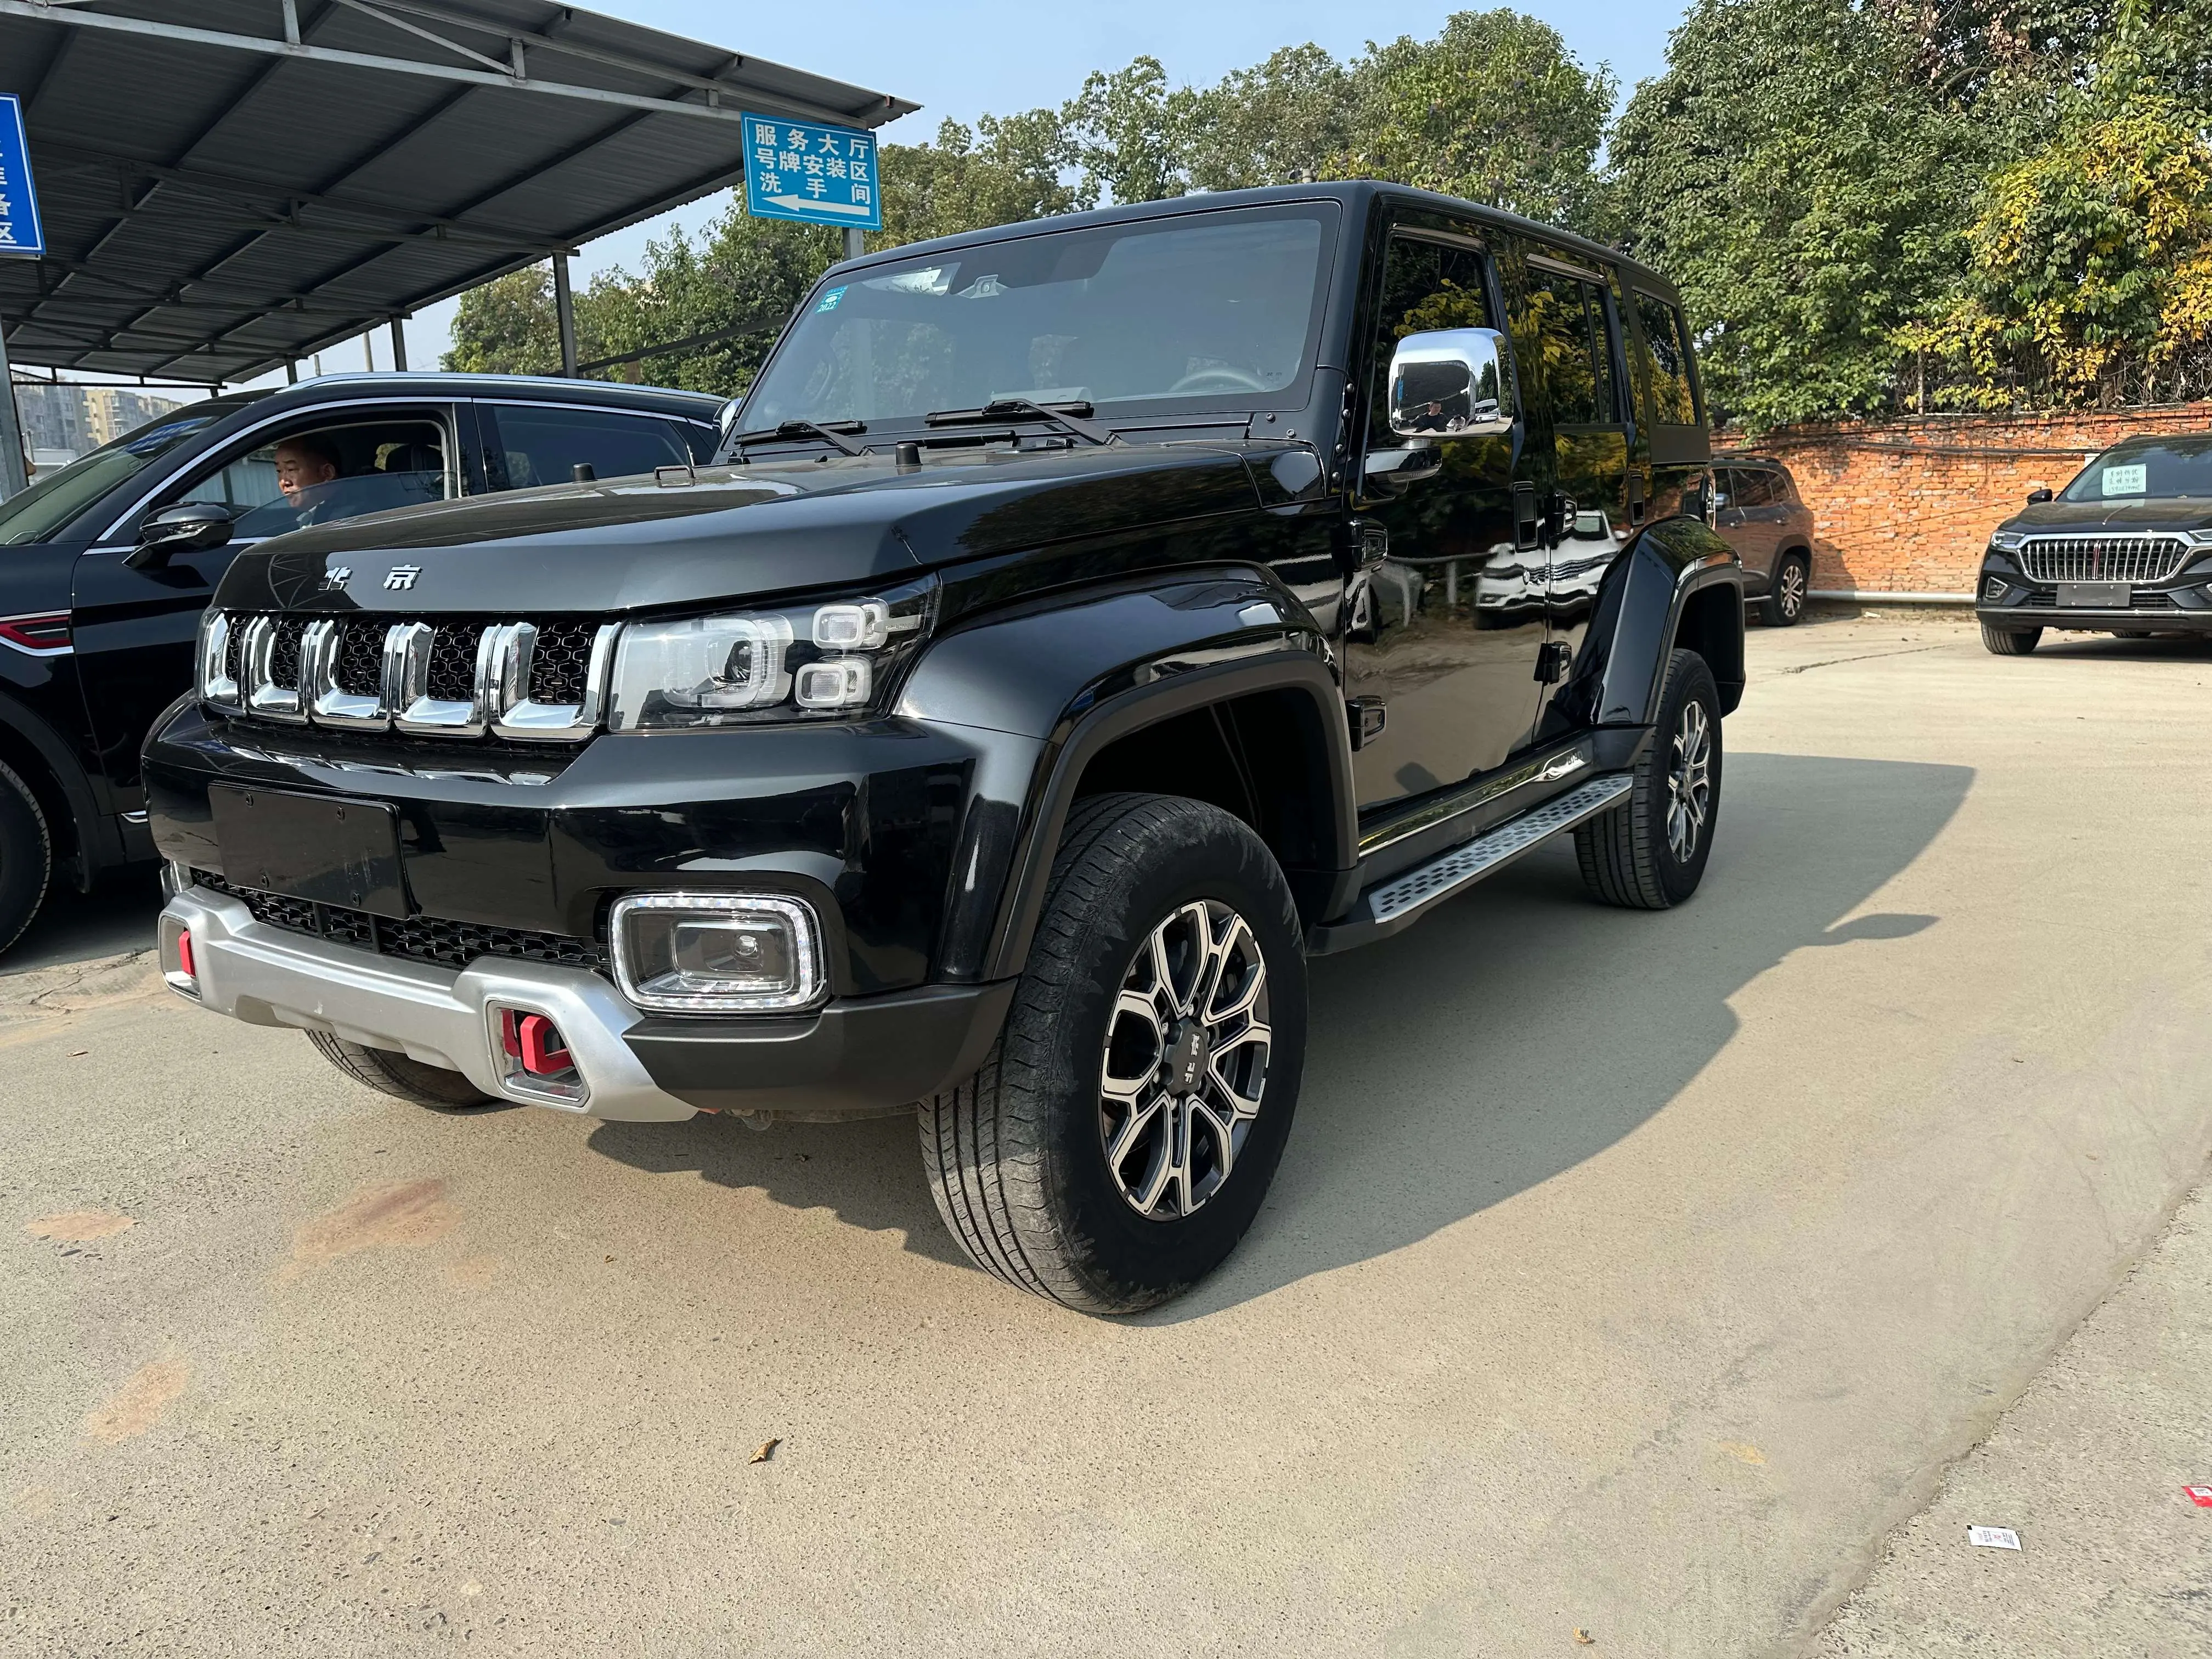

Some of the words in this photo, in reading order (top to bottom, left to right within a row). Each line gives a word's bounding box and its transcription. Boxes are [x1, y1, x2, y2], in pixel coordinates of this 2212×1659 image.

[755, 123, 868, 159] 服务大厅
[754, 148, 870, 182] 号牌安装区
[759, 171, 871, 205] 洗手间
[816, 301, 837, 312] 2022
[318, 565, 421, 590] 北京
